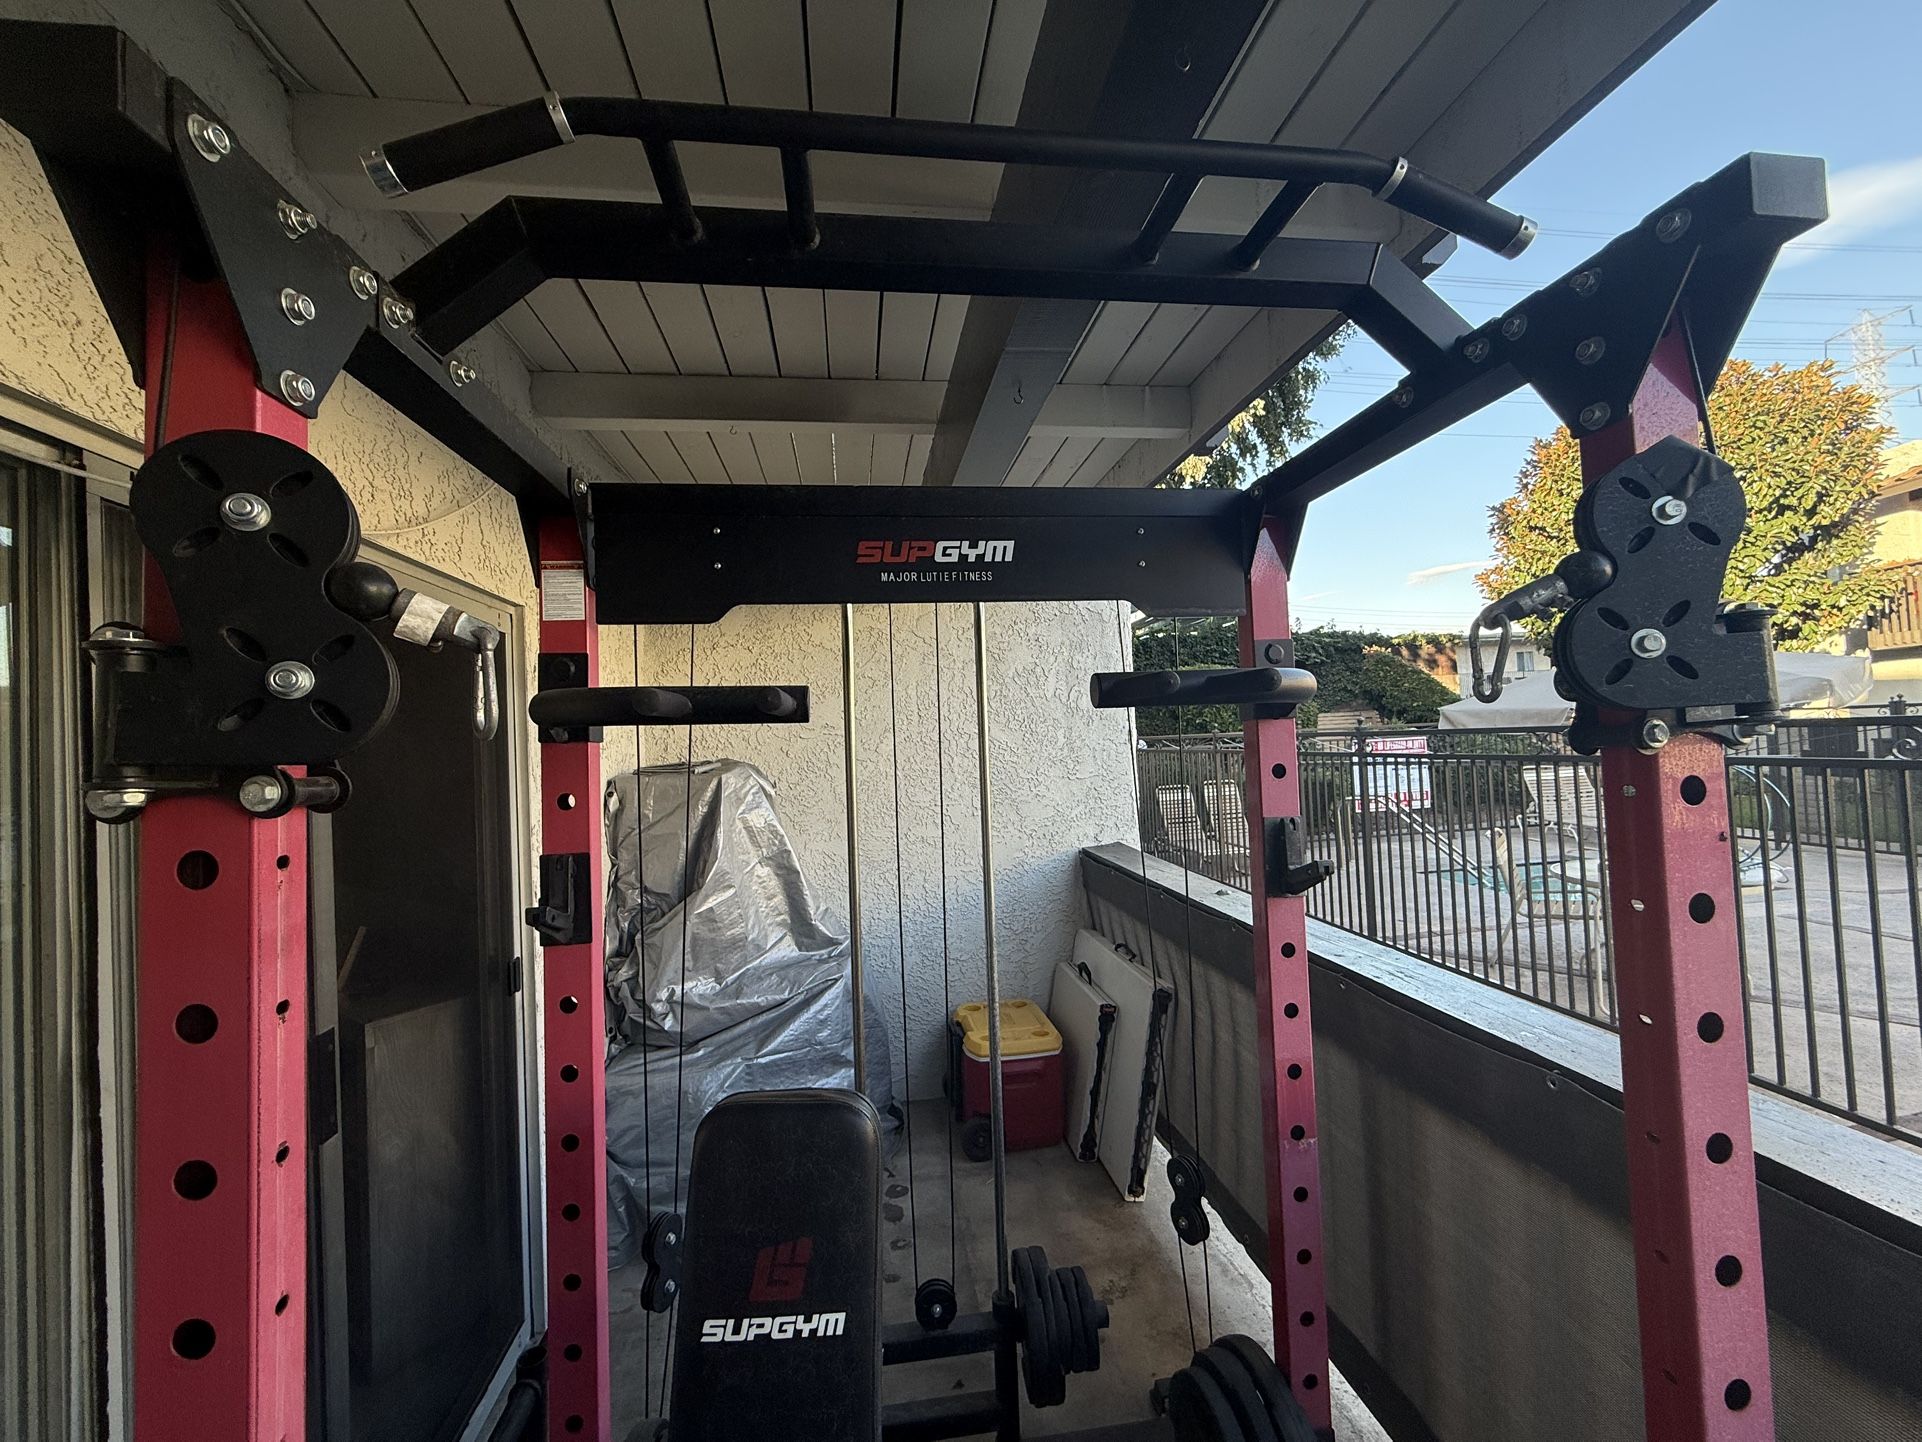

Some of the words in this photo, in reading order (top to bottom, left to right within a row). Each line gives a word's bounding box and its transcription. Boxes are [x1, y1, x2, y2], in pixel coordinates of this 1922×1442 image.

[856, 540, 1015, 563] SUPGYM
[880, 571, 918, 582] MAJOR
[920, 571, 950, 582] LUTIE
[952, 571, 993, 581] FITNESS
[700, 1312, 847, 1342] SUPGYM
